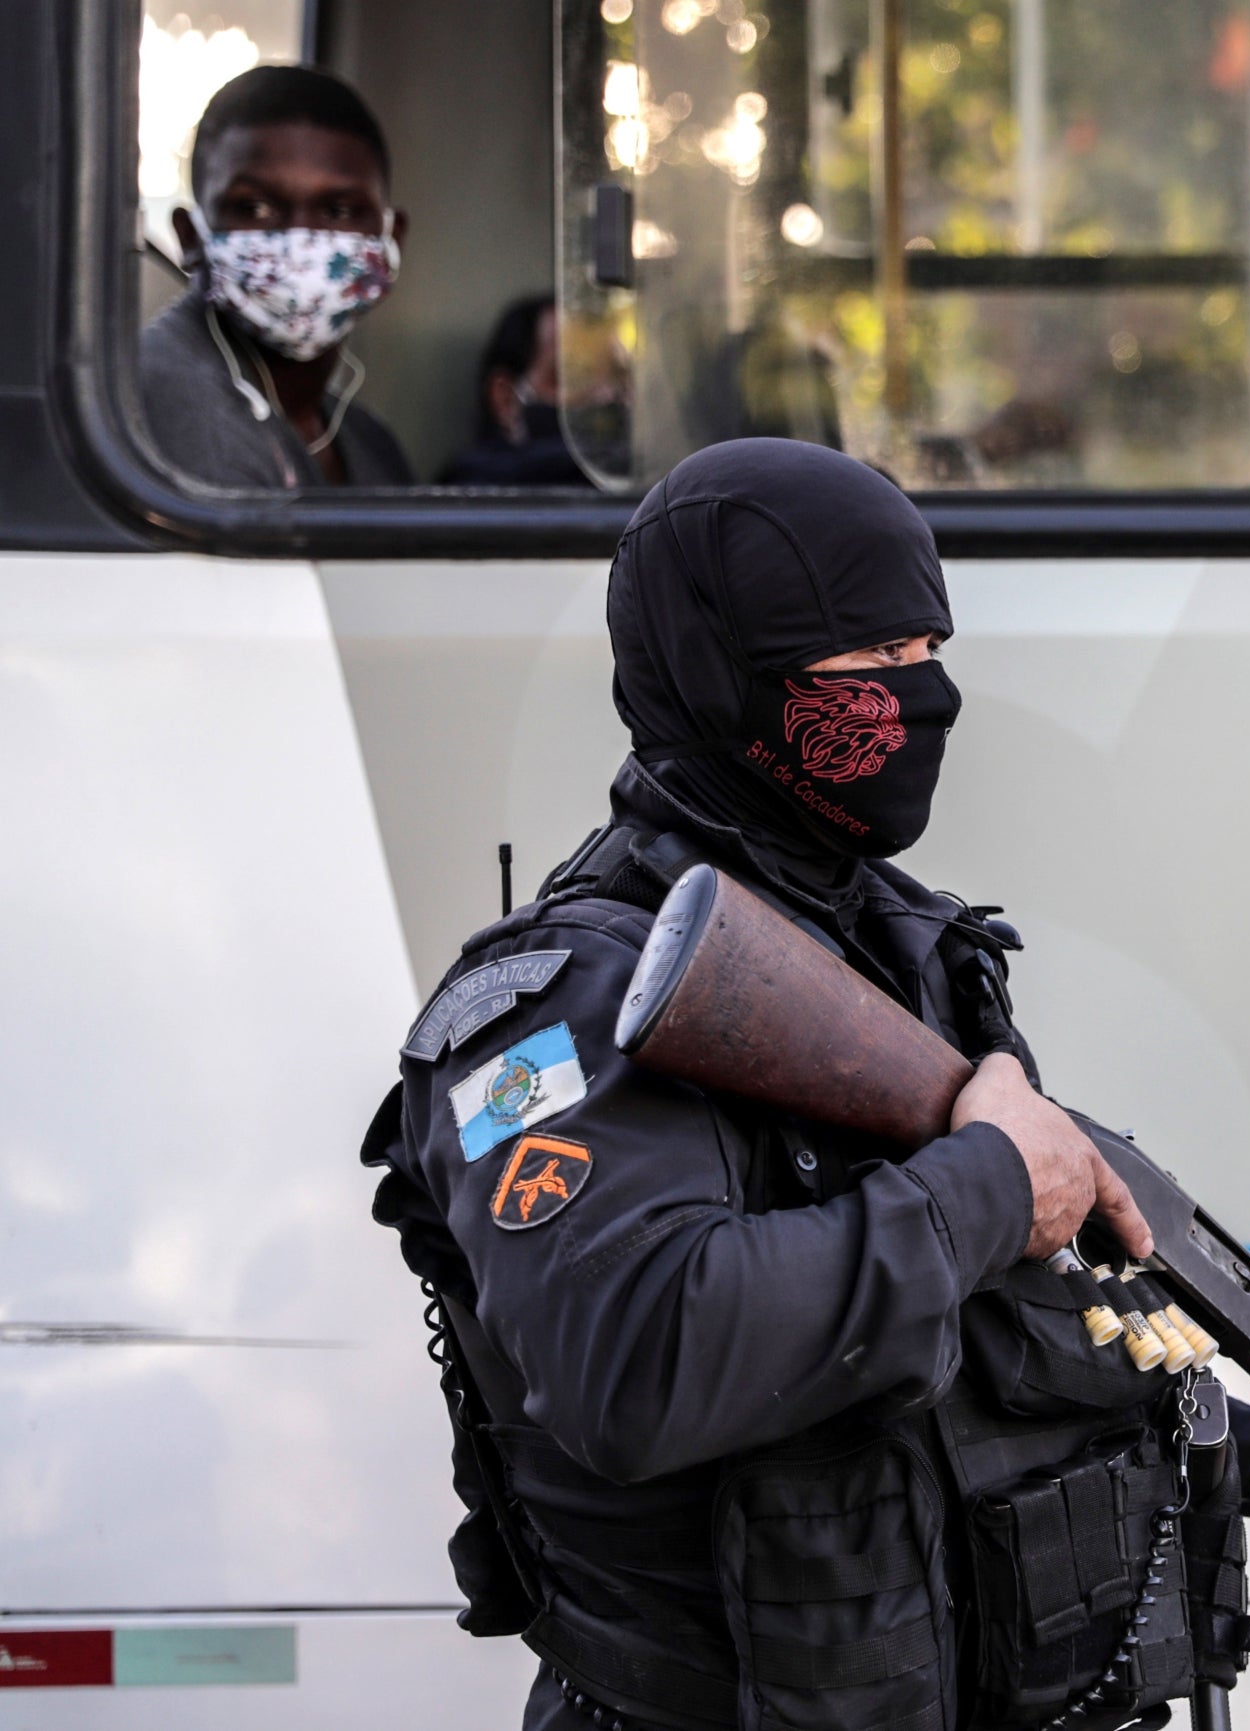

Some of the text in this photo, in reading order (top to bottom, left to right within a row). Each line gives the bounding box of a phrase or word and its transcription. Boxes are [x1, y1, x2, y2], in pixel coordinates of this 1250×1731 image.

[746, 740, 870, 837] Btl de Caçadores
[418, 962, 552, 1048] APLICAÇÕES TÁTICAS
[491, 994, 511, 1013] RJ
